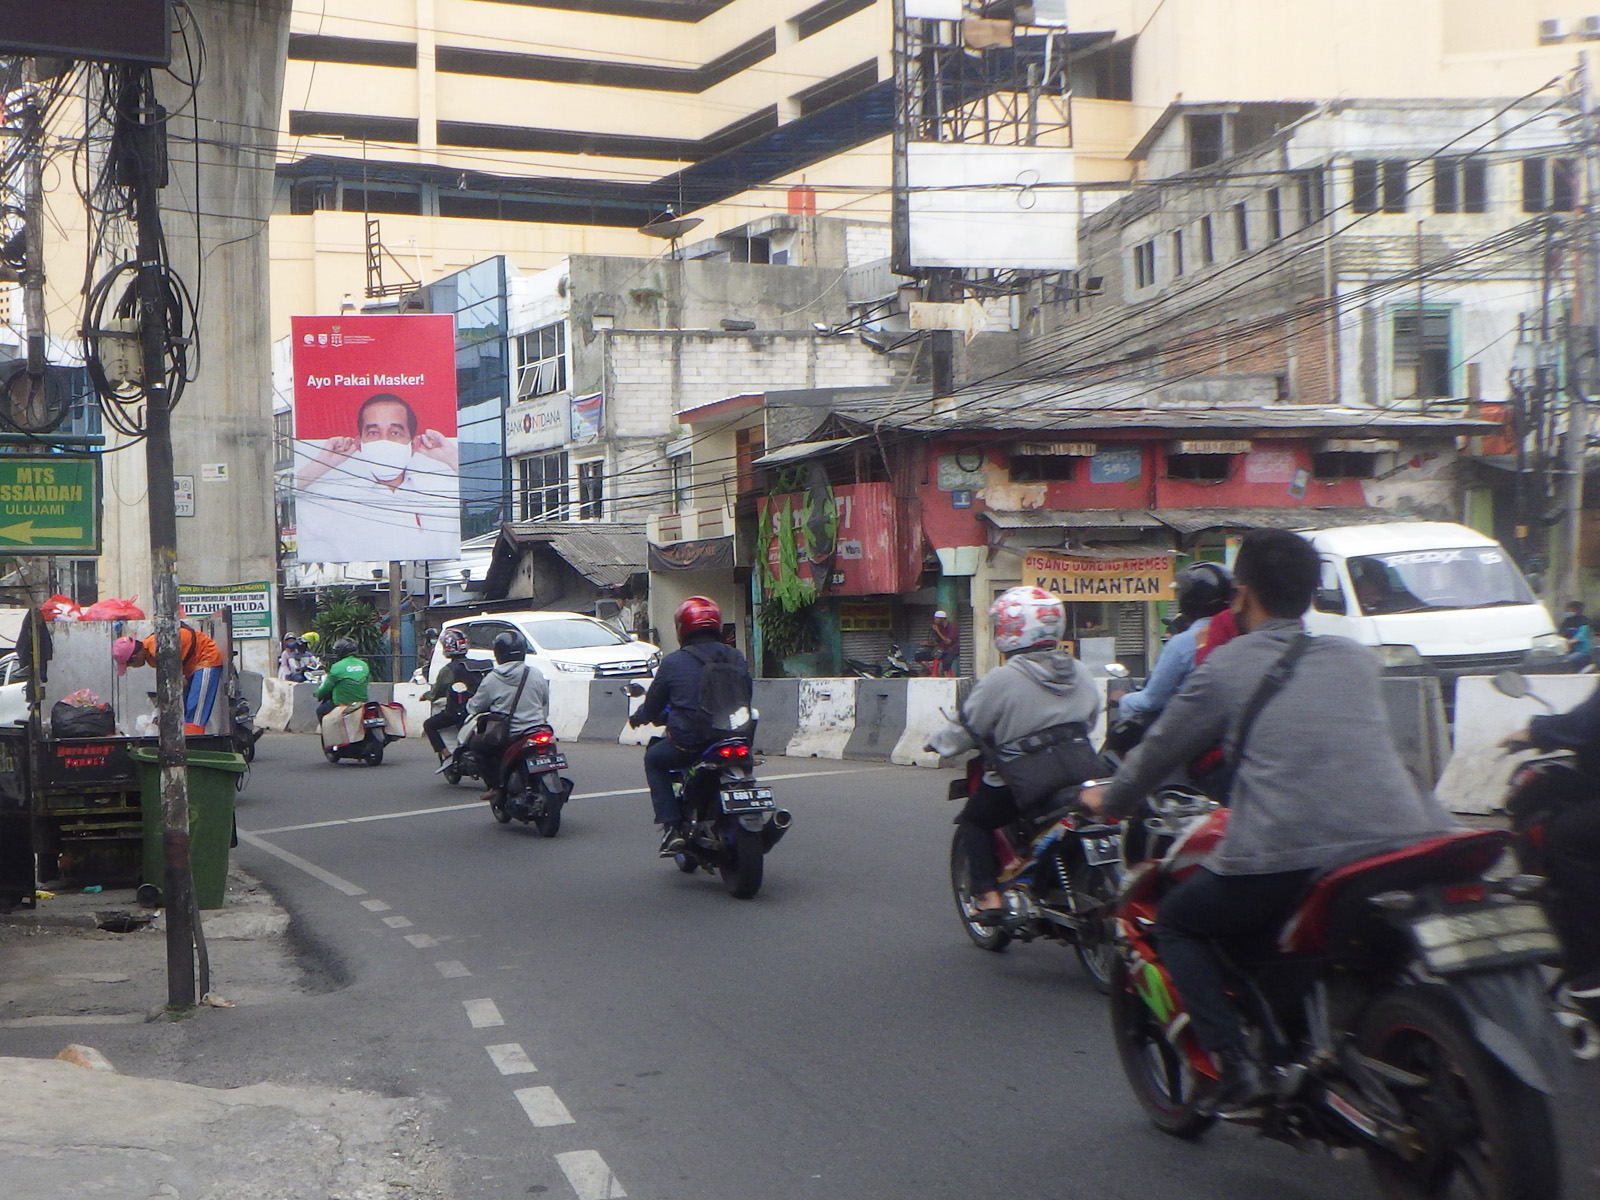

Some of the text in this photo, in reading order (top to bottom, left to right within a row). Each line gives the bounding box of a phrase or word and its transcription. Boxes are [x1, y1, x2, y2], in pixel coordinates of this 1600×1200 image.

[307, 374, 425, 390] Ayo Pakai Masker!
[16, 467, 55, 485] MTS
[5, 504, 66, 516] ULUJAMI
[1026, 557, 1070, 571] PISANG
[1036, 577, 1160, 595] KALIMANTAN
[234, 602, 265, 611] HUDA
